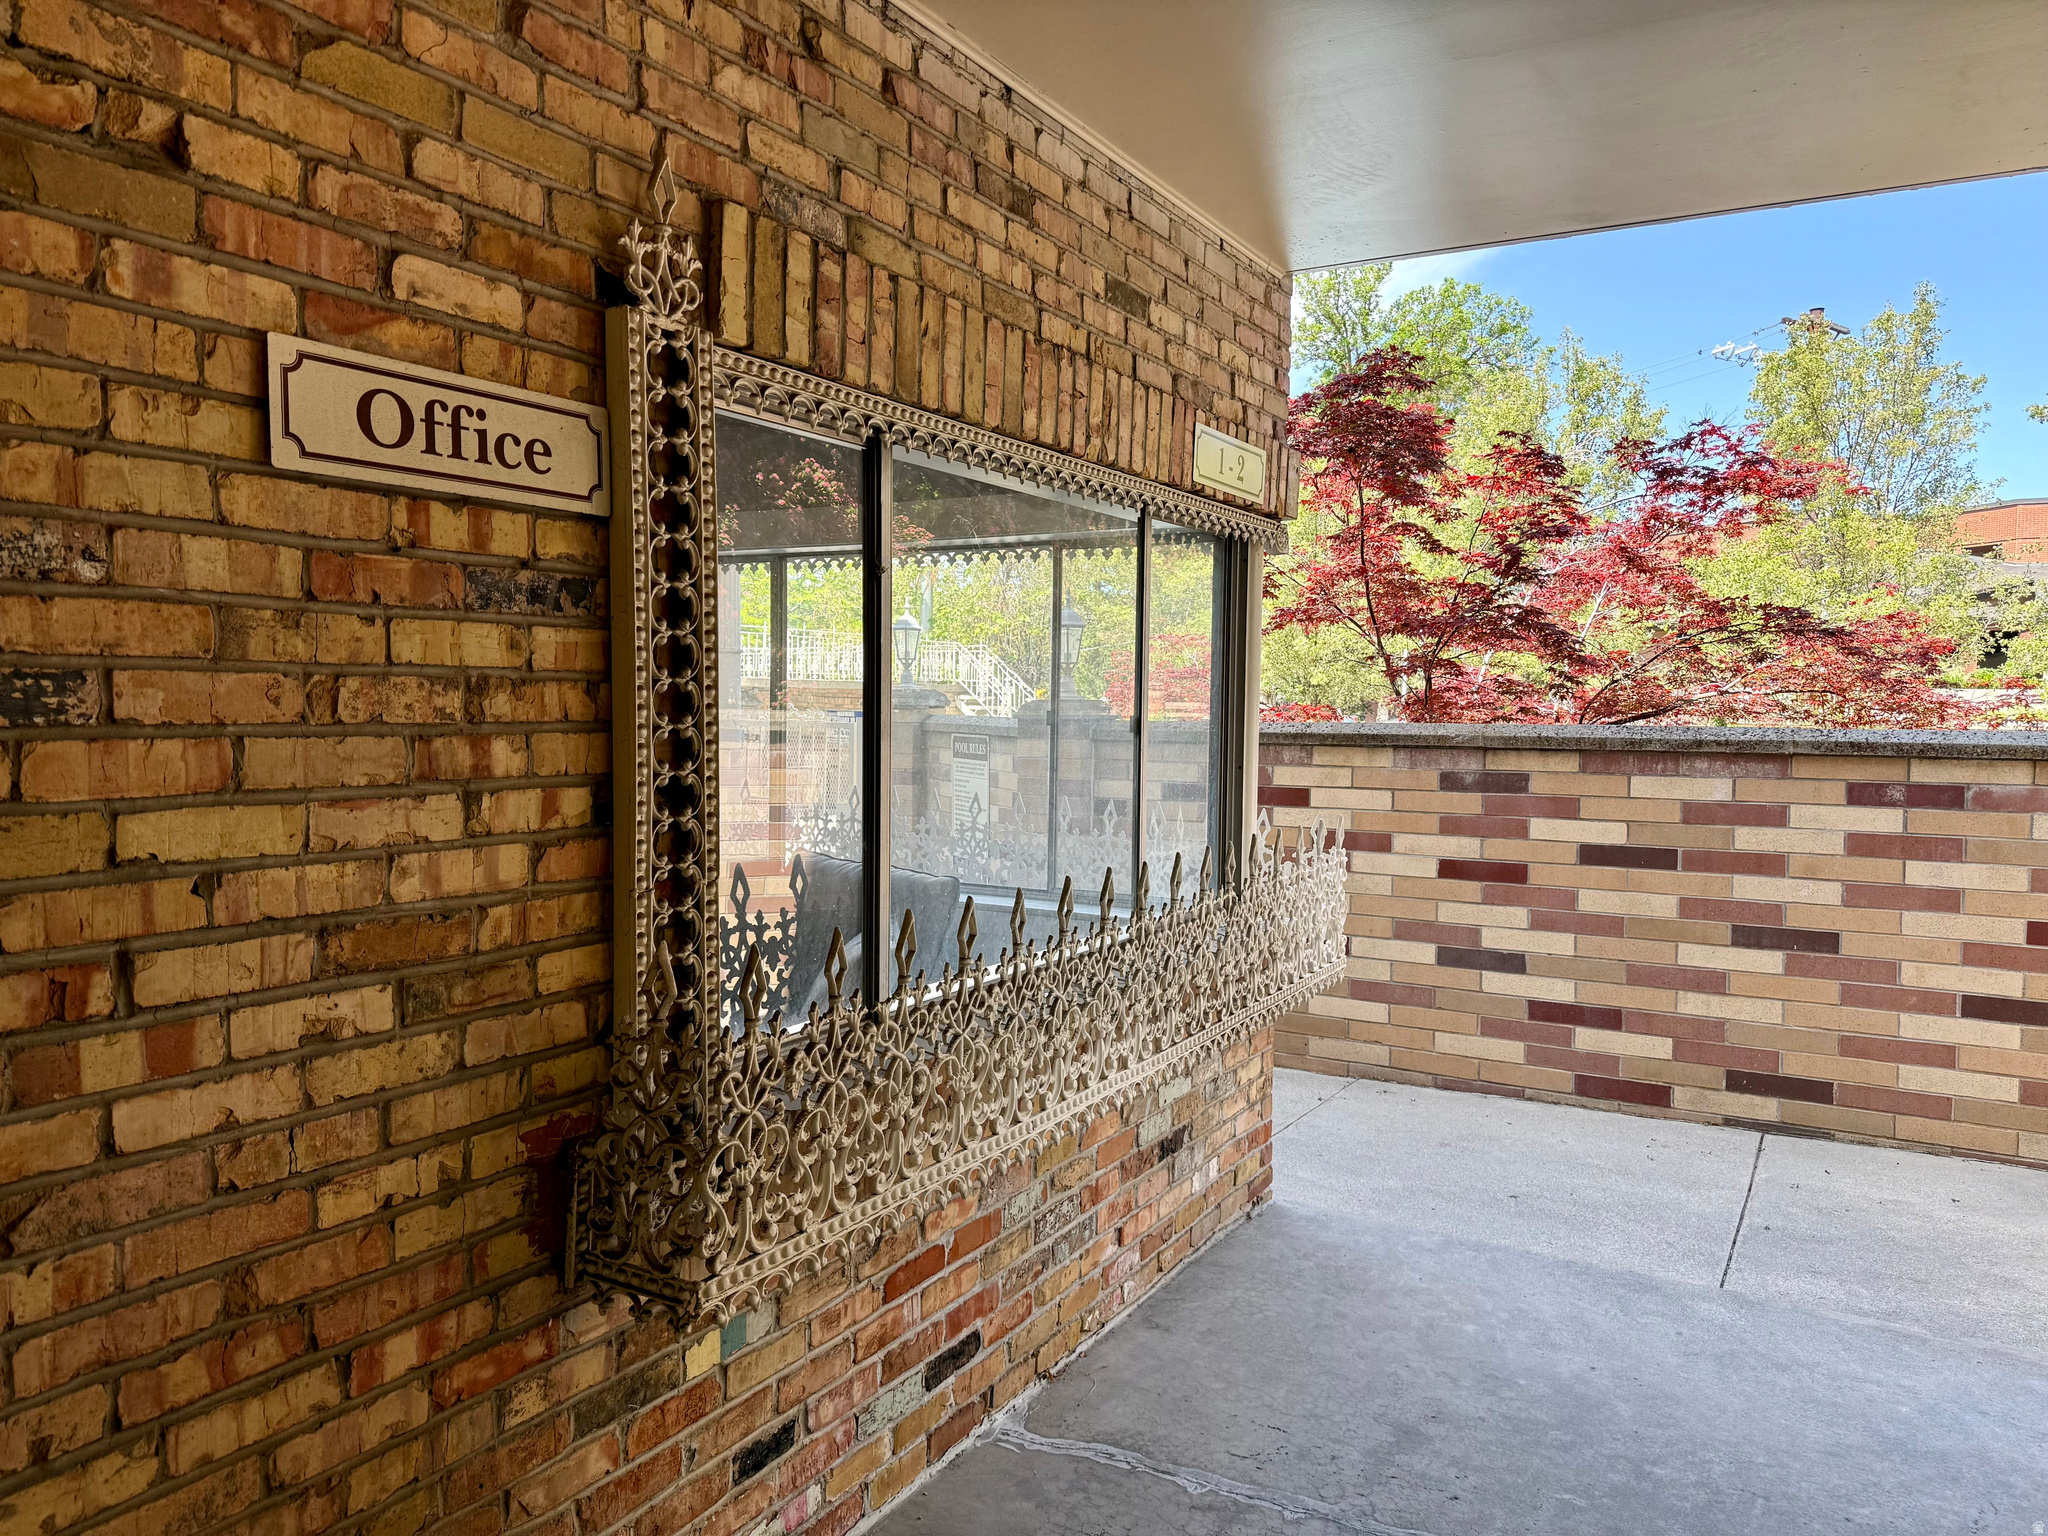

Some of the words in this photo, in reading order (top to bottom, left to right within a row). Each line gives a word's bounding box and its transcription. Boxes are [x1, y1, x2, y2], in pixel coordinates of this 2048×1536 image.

[356, 388, 552, 475] Office
[954, 741, 969, 753] POOL
[969, 742, 986, 755] RULES
